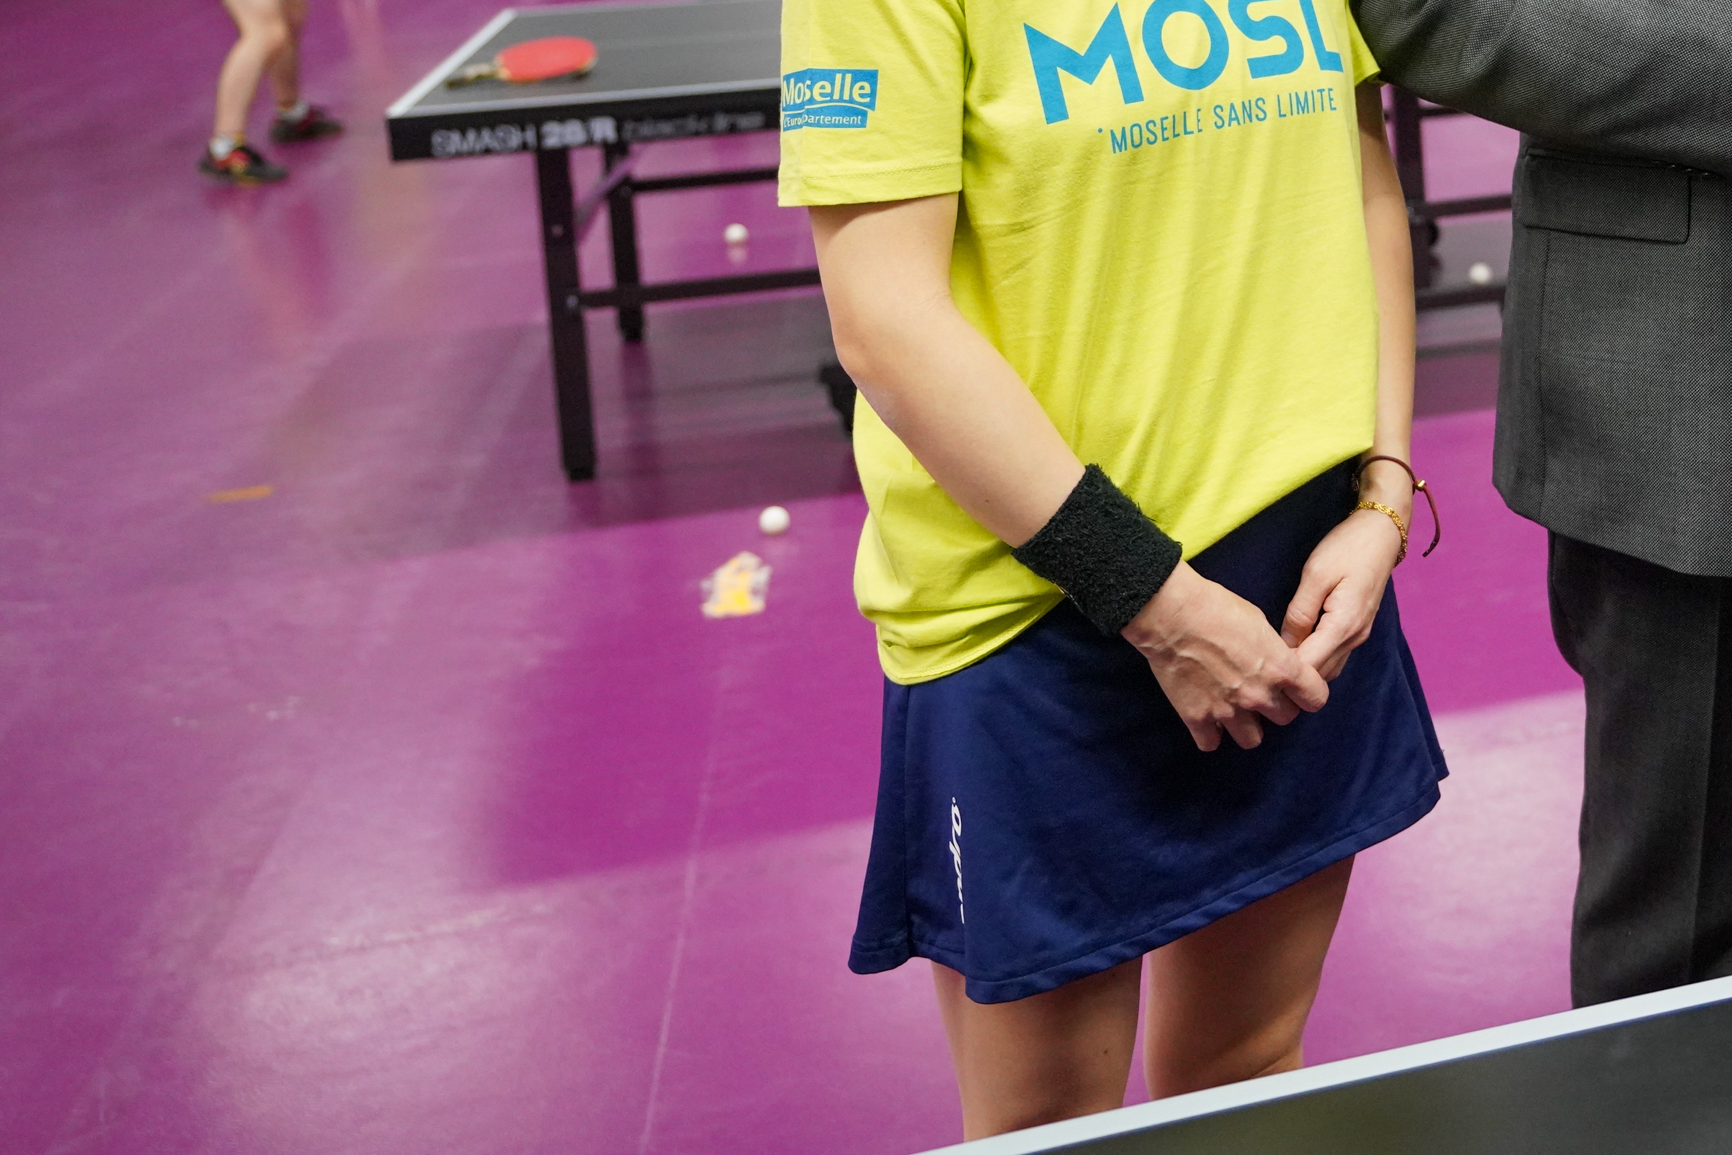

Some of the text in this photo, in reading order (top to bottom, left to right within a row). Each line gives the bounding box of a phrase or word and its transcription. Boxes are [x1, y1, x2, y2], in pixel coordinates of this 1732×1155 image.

[782, 73, 871, 108] Moselle
[1109, 87, 1338, 154] MOSELLE SANS LIMITE
